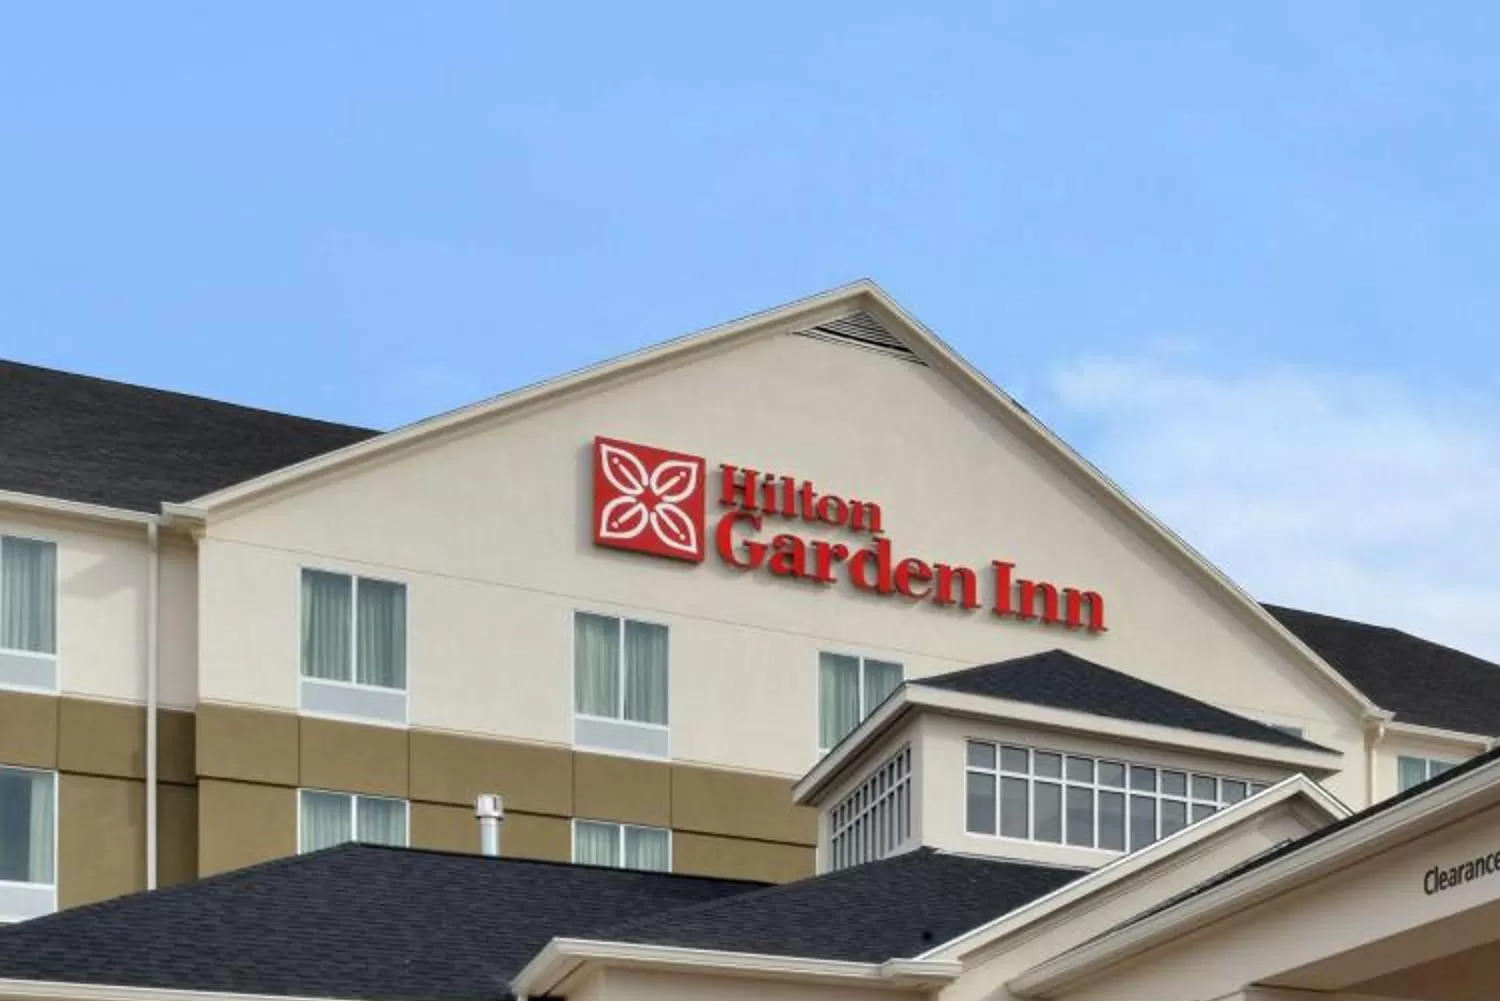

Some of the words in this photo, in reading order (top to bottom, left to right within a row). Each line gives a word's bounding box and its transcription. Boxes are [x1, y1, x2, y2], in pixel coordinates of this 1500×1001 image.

[718, 463, 885, 534] Hilton
[715, 511, 982, 610] Garden
[991, 559, 1109, 634] Inn
